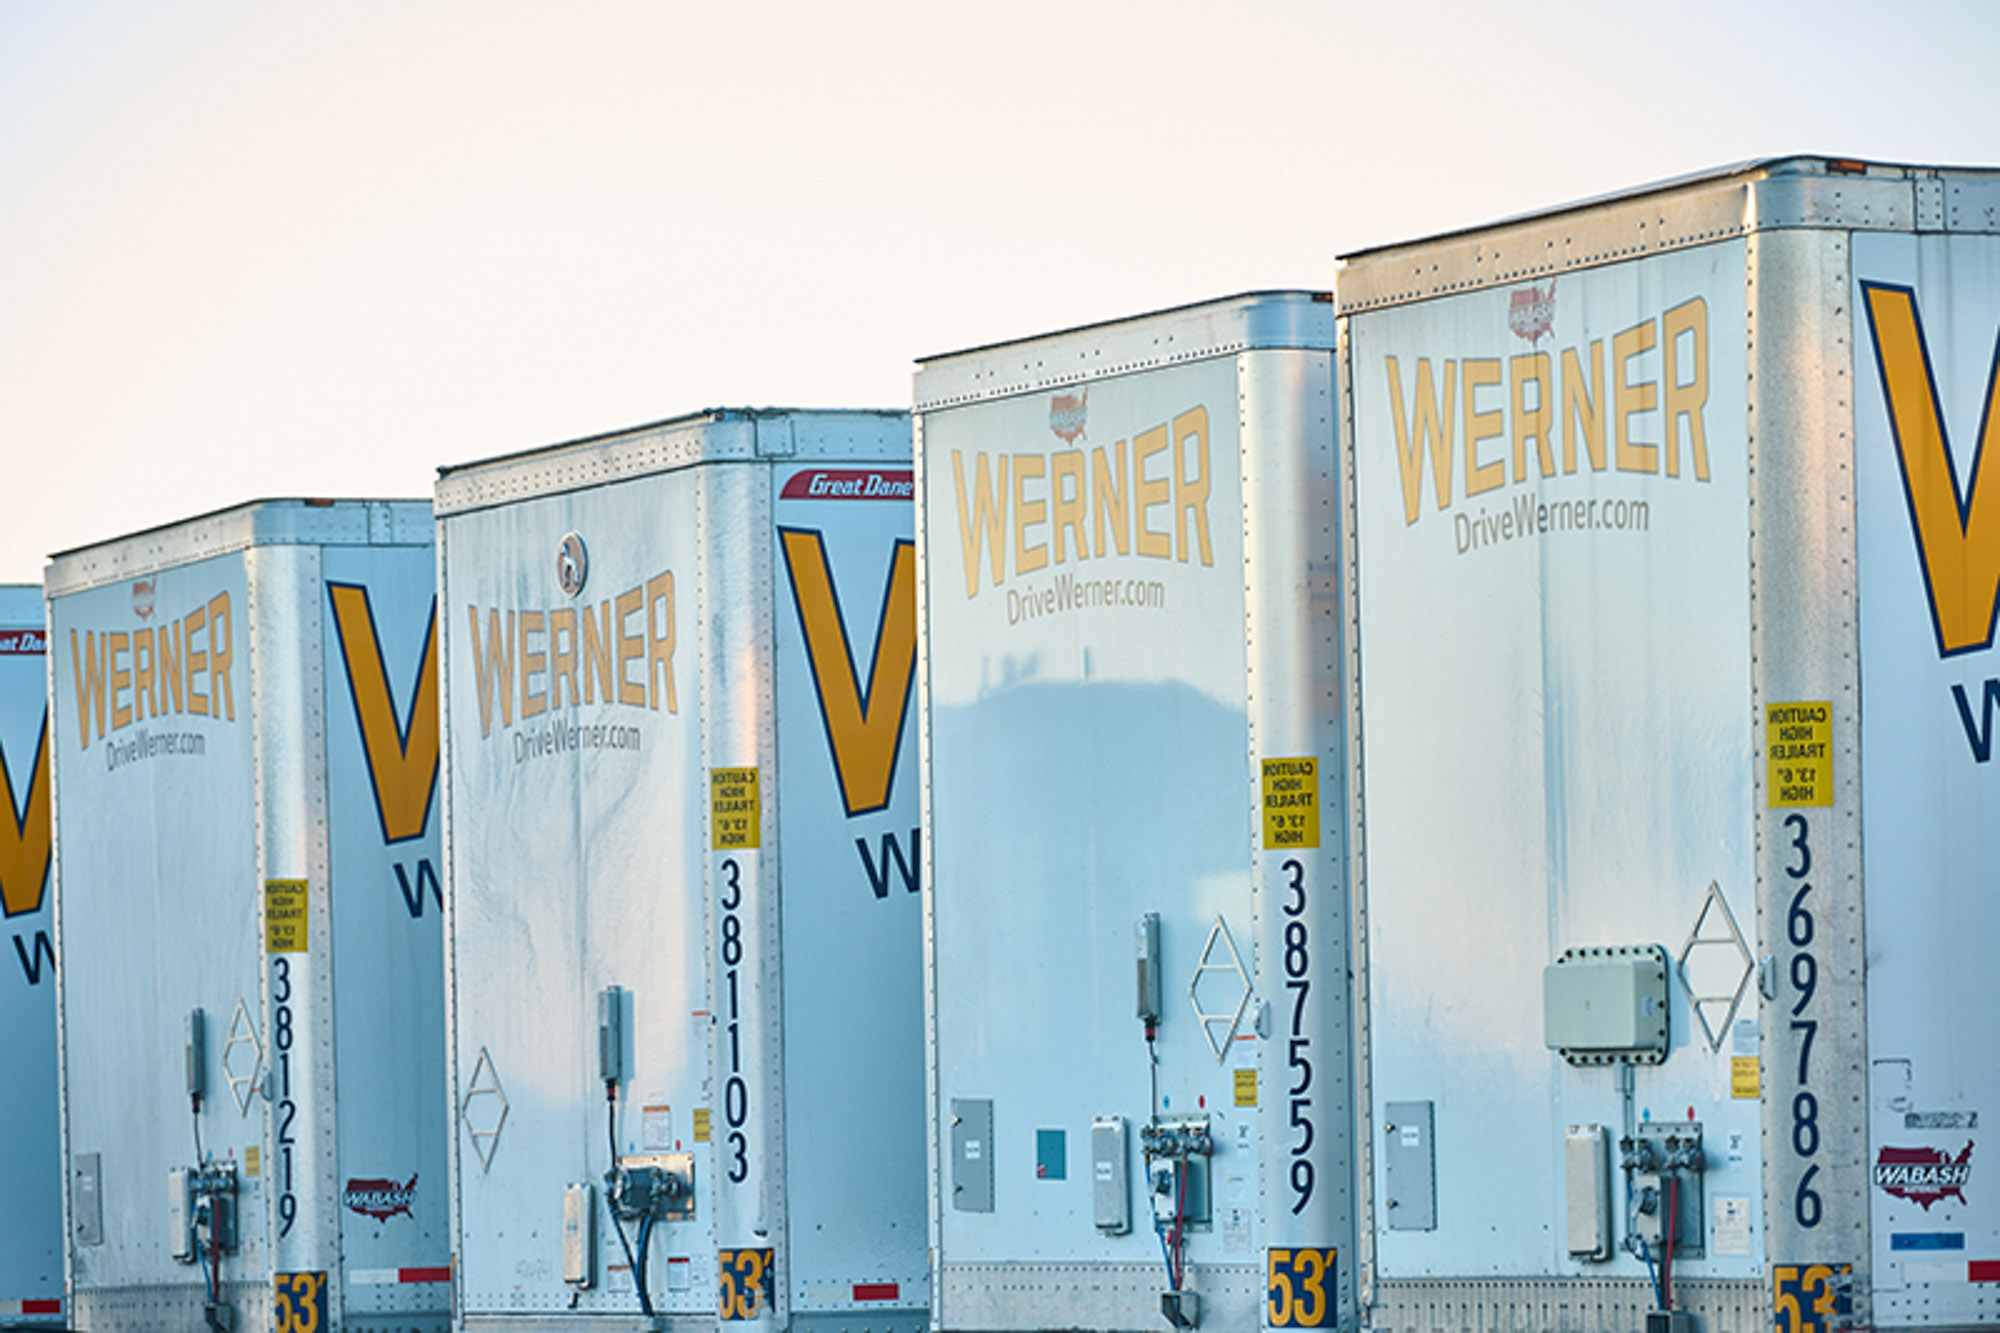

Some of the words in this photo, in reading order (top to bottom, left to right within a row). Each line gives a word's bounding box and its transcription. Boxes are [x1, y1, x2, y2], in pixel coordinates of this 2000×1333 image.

[809, 473, 863, 495] Great
[863, 474, 914, 496] Dane
[1386, 295, 1711, 526] WERNER
[951, 404, 1213, 600] WERNER
[1454, 493, 1649, 555] DriveWerner.com
[70, 590, 235, 751] WERNER
[468, 570, 678, 740] WERNER
[1006, 574, 1165, 626] DriveWerner.com
[107, 730, 205, 772] DriveWerner.com
[514, 720, 641, 763] DriveWerner.com
[273, 956, 296, 1238] 381219
[721, 858, 749, 1184] 381103
[1281, 859, 1315, 1215] 387559
[1783, 812, 1824, 1228] 369786
[1875, 1165, 1969, 1186] WABASH
[1268, 1248, 1338, 1327] 53'
